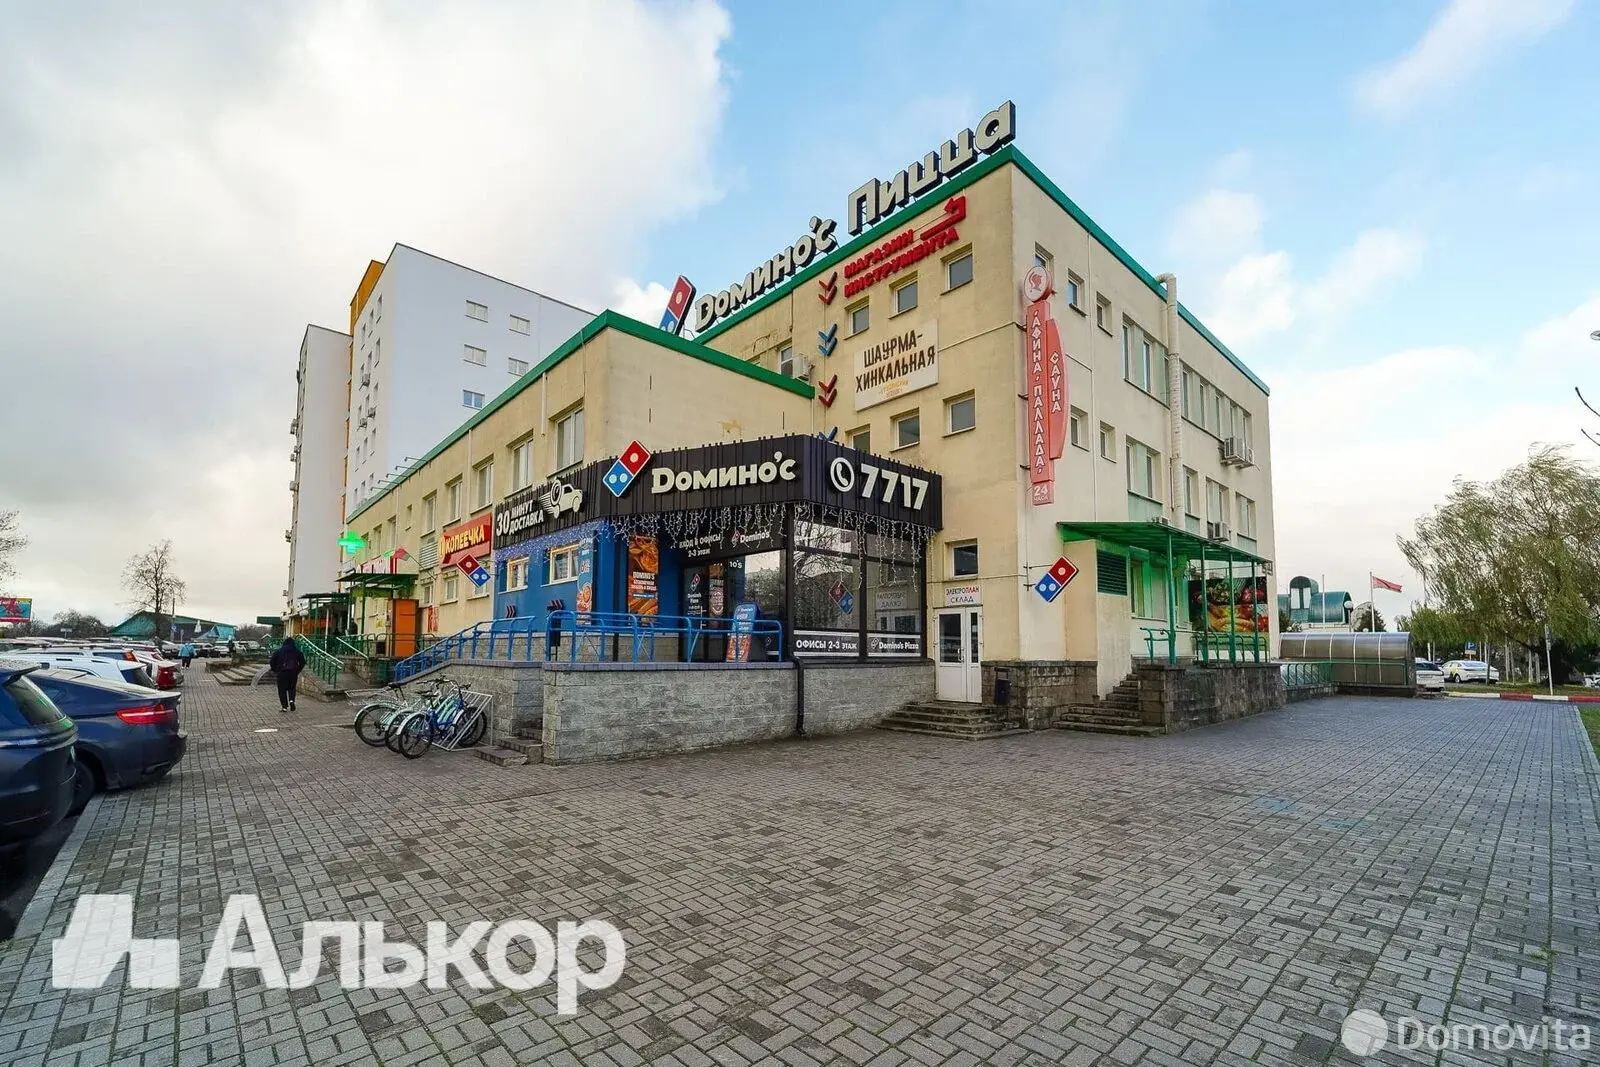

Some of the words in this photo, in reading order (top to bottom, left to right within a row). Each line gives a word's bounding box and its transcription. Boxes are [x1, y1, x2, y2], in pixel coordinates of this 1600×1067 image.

[847, 100, 1015, 235] Пицца
[844, 229, 914, 278] МАГАЗИН
[844, 227, 959, 298] ИНСТРУМЕНТА
[863, 329, 923, 368] ШАУРМА-
[855, 345, 936, 393] ХИНКАЛЬНАЯ
[1049, 352, 1062, 413] САУНА
[860, 463, 929, 510] 7717
[1033, 485, 1048, 497] 24
[496, 510, 510, 536] 30
[511, 500, 533, 516] МИНУТ
[509, 510, 544, 536] ДОСТАВКА
[740, 528, 770, 543] Domino's
[796, 639, 827, 649] ОФИСЫ
[828, 641, 840, 650] 2-3
[879, 641, 904, 649] Domino's
[904, 642, 919, 650] Pizza
